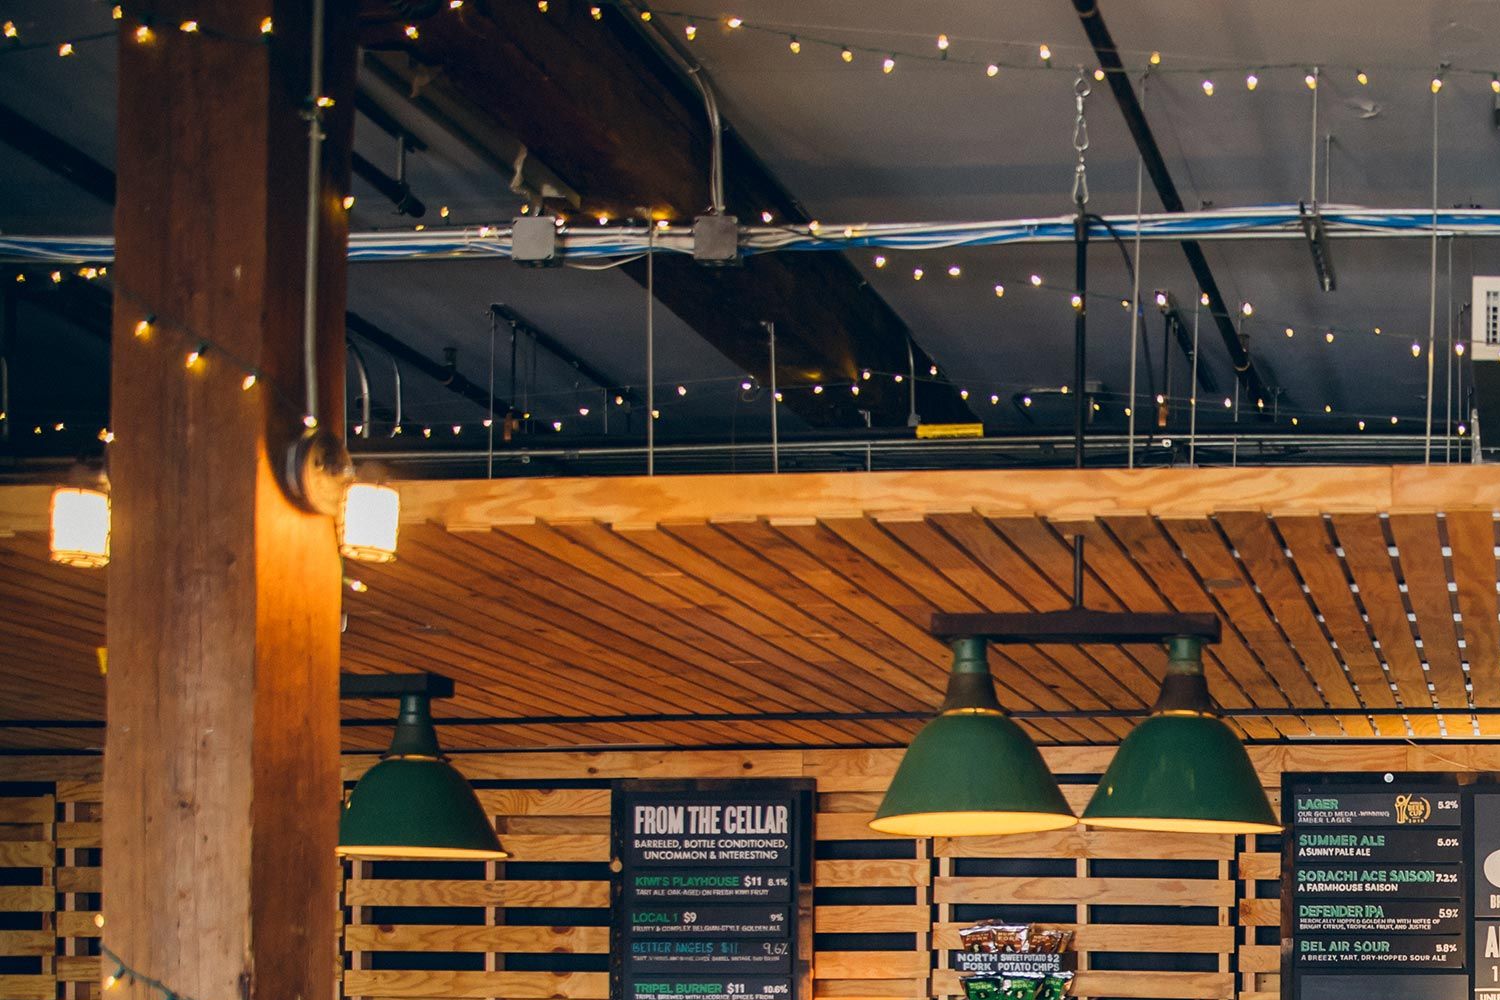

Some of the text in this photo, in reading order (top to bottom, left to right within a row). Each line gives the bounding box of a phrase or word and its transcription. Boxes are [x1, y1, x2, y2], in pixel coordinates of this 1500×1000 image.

[1298, 799, 1458, 810] LAGER 5.2%
[634, 806, 788, 834] FROM THE CELLAR
[634, 840, 788, 850] BARRELED, BOTTLE CONDITIONED,
[1299, 835, 1458, 846] SUMMER ALE 5.0%
[644, 851, 778, 860] UNCOMMON & INTERESTING
[1298, 848, 1370, 856] A SUNNY PALE ALE
[1298, 870, 1458, 882] SORACHI ACE SAISON 7.2%
[673, 876, 740, 886] PLAYHOUSE
[744, 876, 762, 888] $11
[768, 878, 788, 886] 8.1%
[1298, 884, 1398, 892] A FARMHOUSE SAISON
[1300, 905, 1384, 918] DEFENDER IPA
[632, 912, 784, 923] LOCAL $9 9%
[632, 942, 788, 955] BETTER ANGELS 9.6%
[1300, 941, 1326, 952] BEL
[1329, 941, 1350, 952] AIR
[1354, 941, 1390, 952] SOUR
[958, 954, 1060, 962] NORTH SWEET POTATO $2
[963, 963, 1060, 971] FORK POTATO CHIPS
[634, 983, 788, 994] TRIPEL BURNER $11 10.6%
